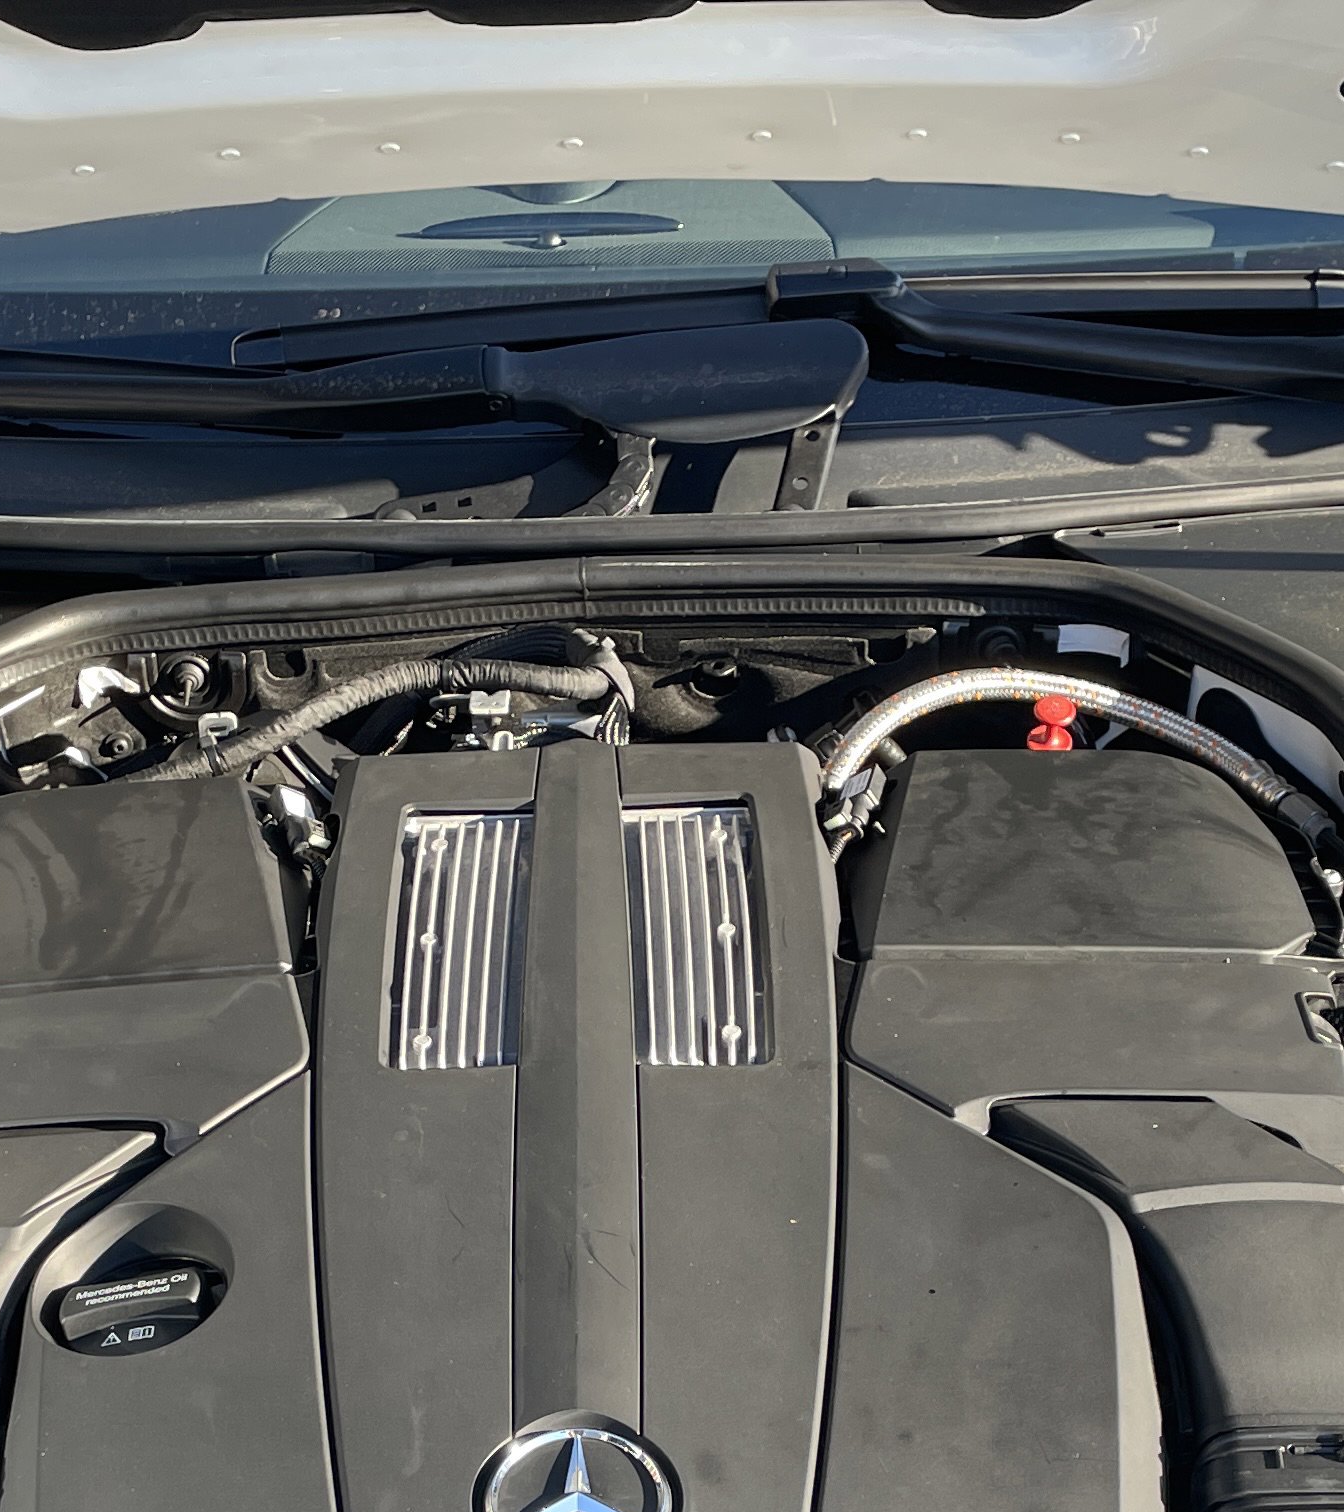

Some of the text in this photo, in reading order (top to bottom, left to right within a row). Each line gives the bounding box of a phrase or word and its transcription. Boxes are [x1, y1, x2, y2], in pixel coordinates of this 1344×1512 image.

[75, 1273, 189, 1301] Mercedes-Benz Oil
[84, 1283, 171, 1306] recommended
